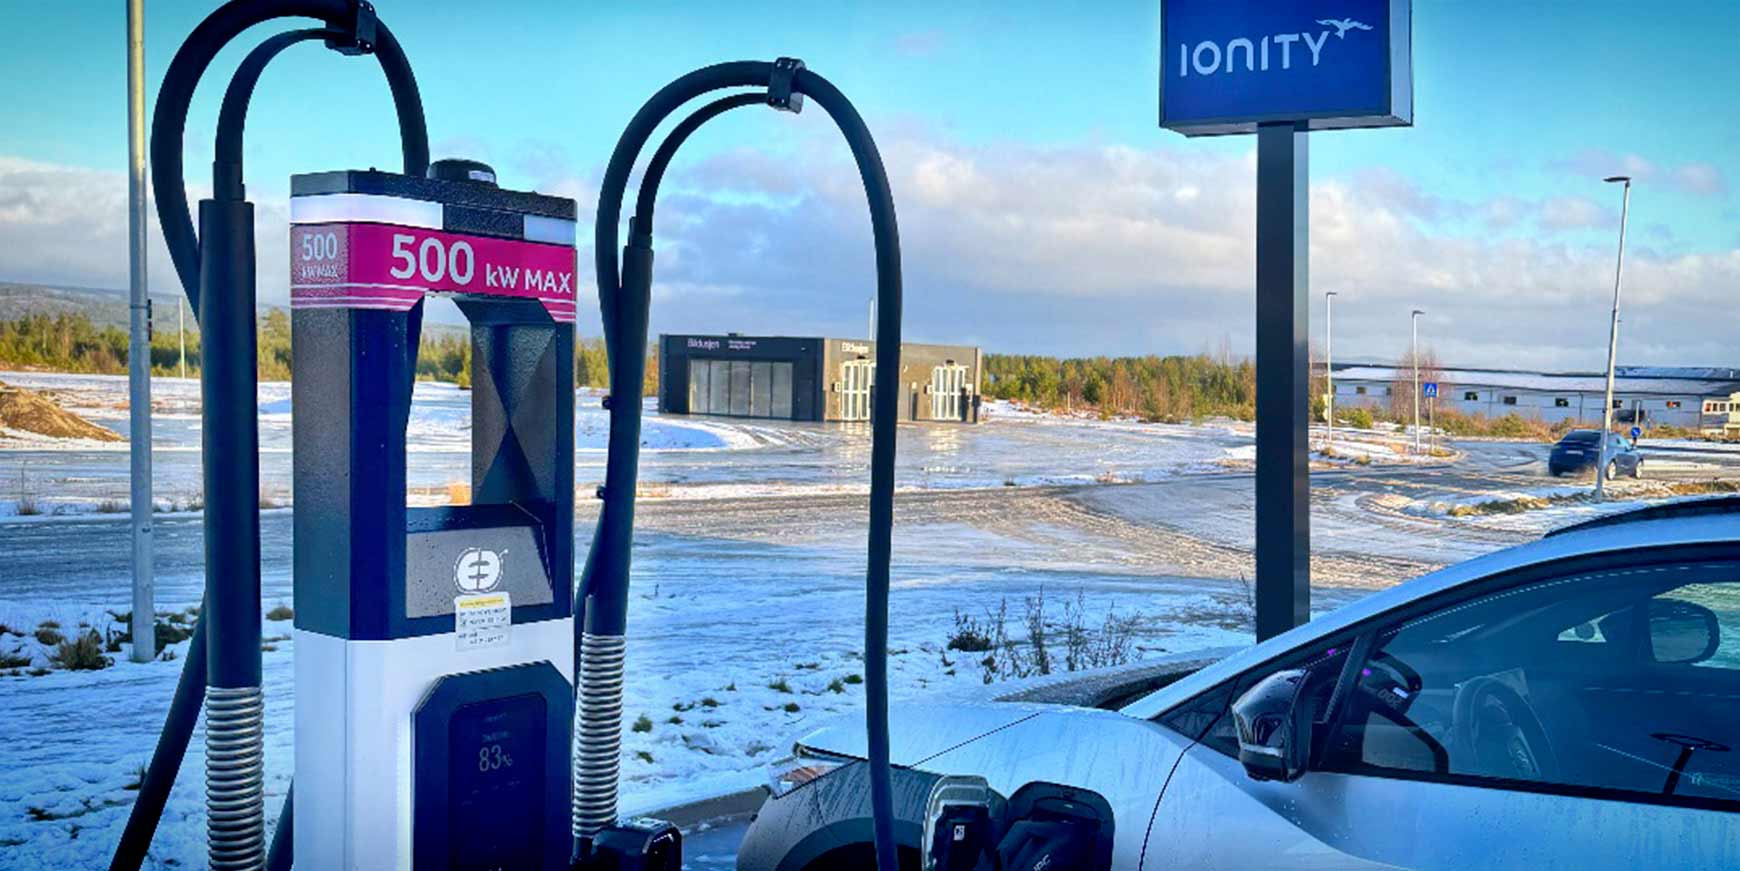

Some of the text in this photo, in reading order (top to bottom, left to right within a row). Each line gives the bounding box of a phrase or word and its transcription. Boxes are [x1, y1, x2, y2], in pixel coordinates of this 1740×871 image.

[1180, 31, 1330, 77] IONITY
[302, 232, 337, 261] 500
[390, 234, 572, 293] 500 kW MAX
